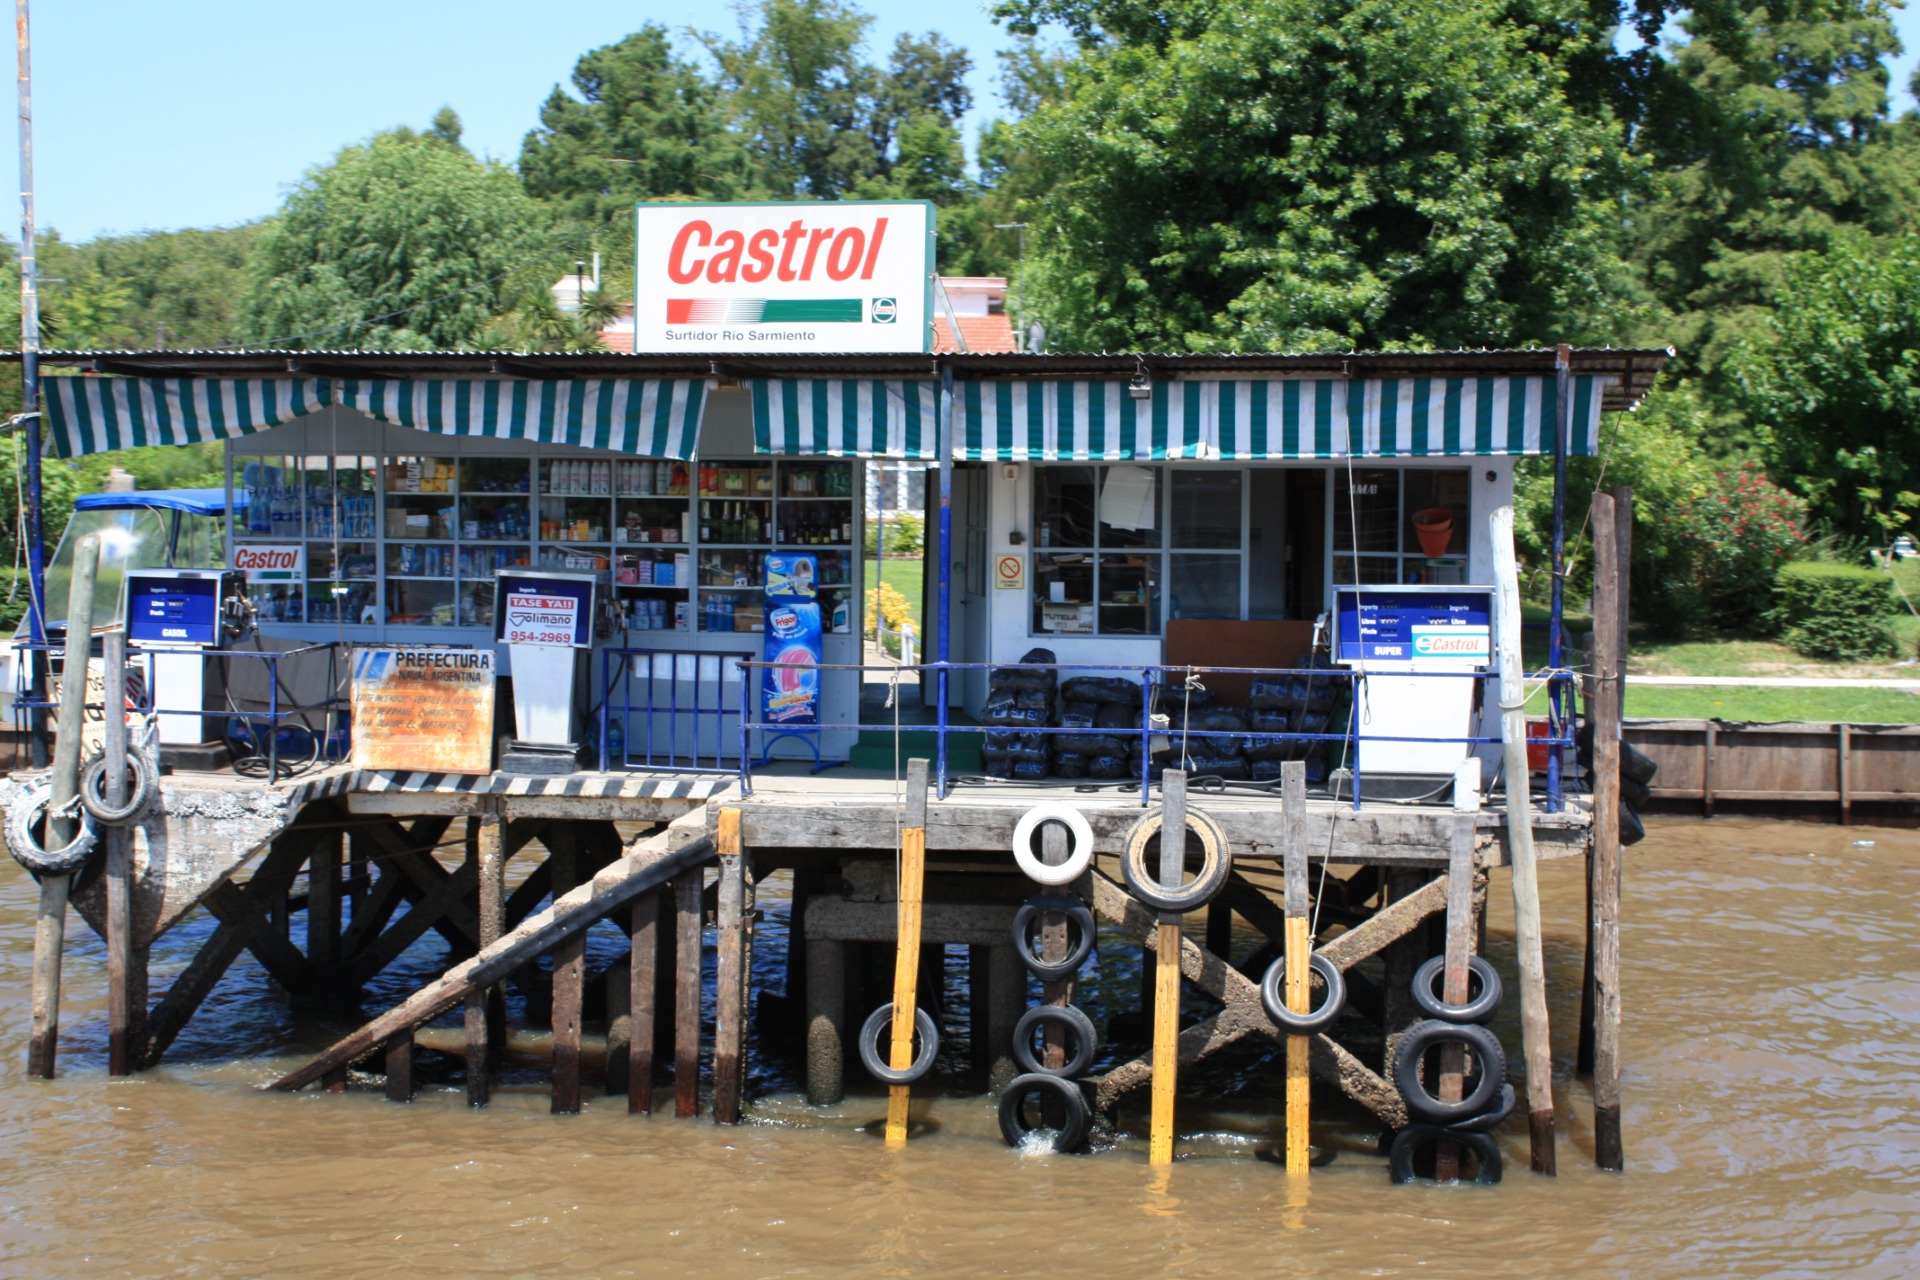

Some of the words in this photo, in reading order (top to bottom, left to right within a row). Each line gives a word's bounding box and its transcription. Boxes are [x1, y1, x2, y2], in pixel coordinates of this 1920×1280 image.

[667, 217, 889, 285] Castrol
[665, 330, 719, 341] Surtidor
[722, 330, 744, 341] Río
[748, 330, 816, 341] Sarmiento
[235, 549, 299, 569] Castrol
[511, 598, 542, 608] TASE
[546, 600, 573, 609] YA!!
[509, 612, 574, 628] Solimano
[775, 616, 797, 627] Frigor
[1044, 613, 1078, 621] TUTELA
[511, 631, 571, 643] 954-2969
[1432, 638, 1480, 651] Castrol
[1374, 646, 1403, 656] SUPER
[395, 651, 490, 669] PREFECTURA
[398, 670, 426, 681] NAVAL
[431, 671, 482, 683] ARGENTINA
